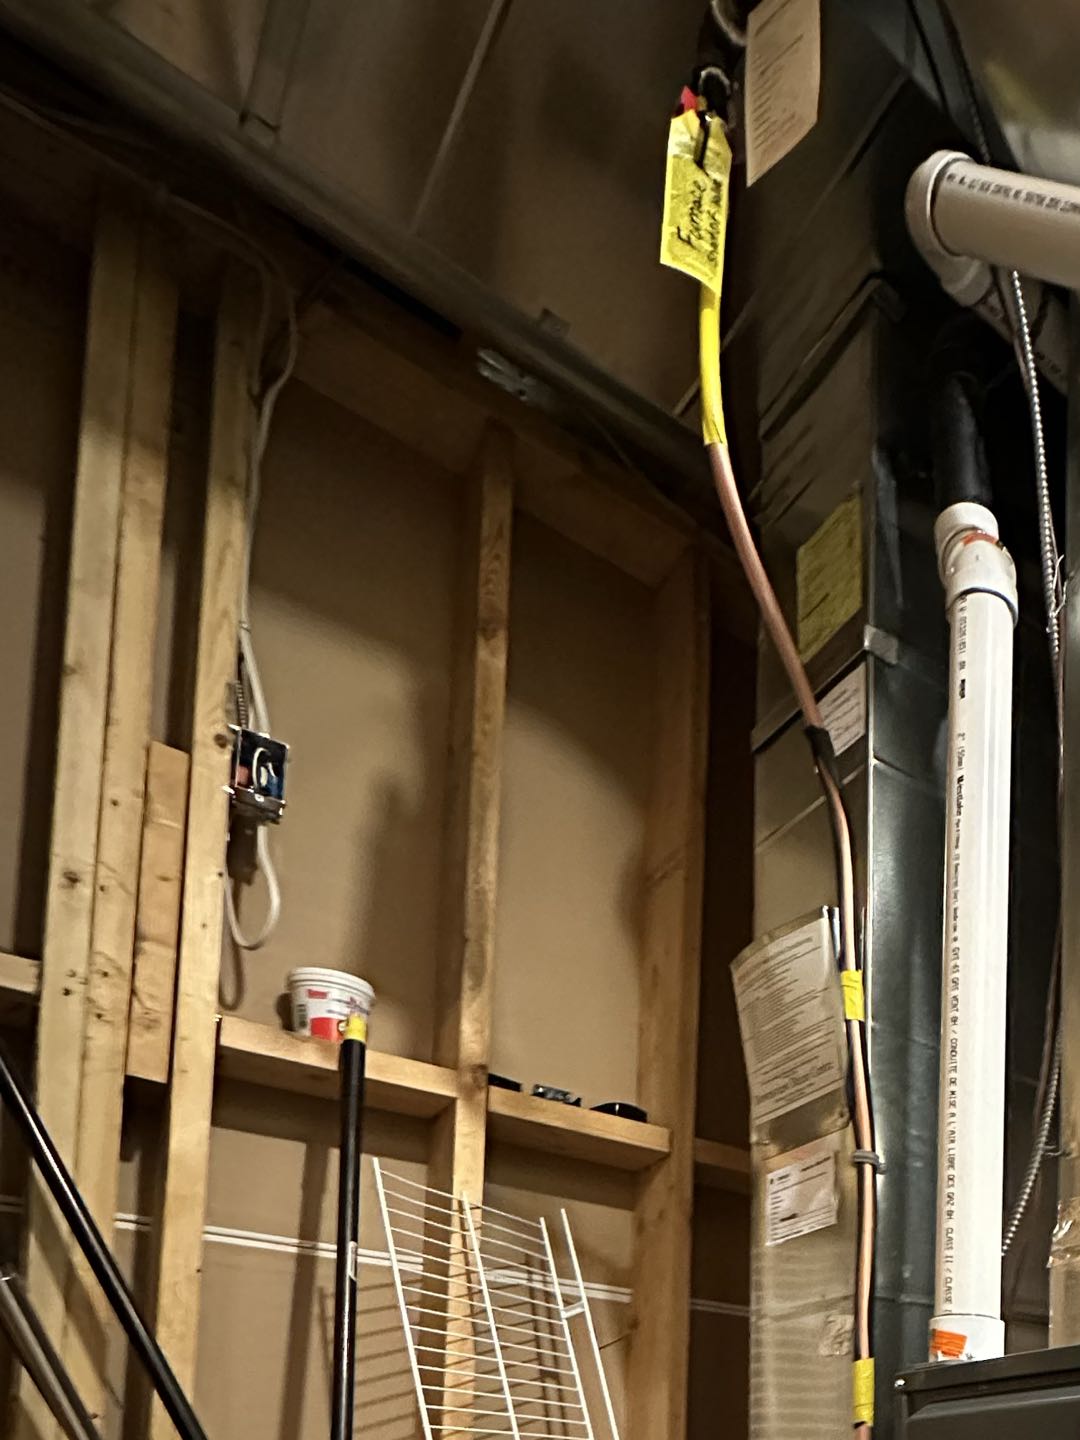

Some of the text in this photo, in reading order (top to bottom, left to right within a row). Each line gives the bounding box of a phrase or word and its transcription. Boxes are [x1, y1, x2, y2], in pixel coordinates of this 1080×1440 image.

[950, 995, 959, 1013] VENT
[949, 1037, 959, 1074] CONDUITE
[949, 1077, 958, 1087] DE
[948, 1090, 958, 1110] MISE
[947, 1147, 956, 1171] LIBRE
[945, 1227, 955, 1251] CLASS
[944, 1276, 955, 1305] CLASSE
